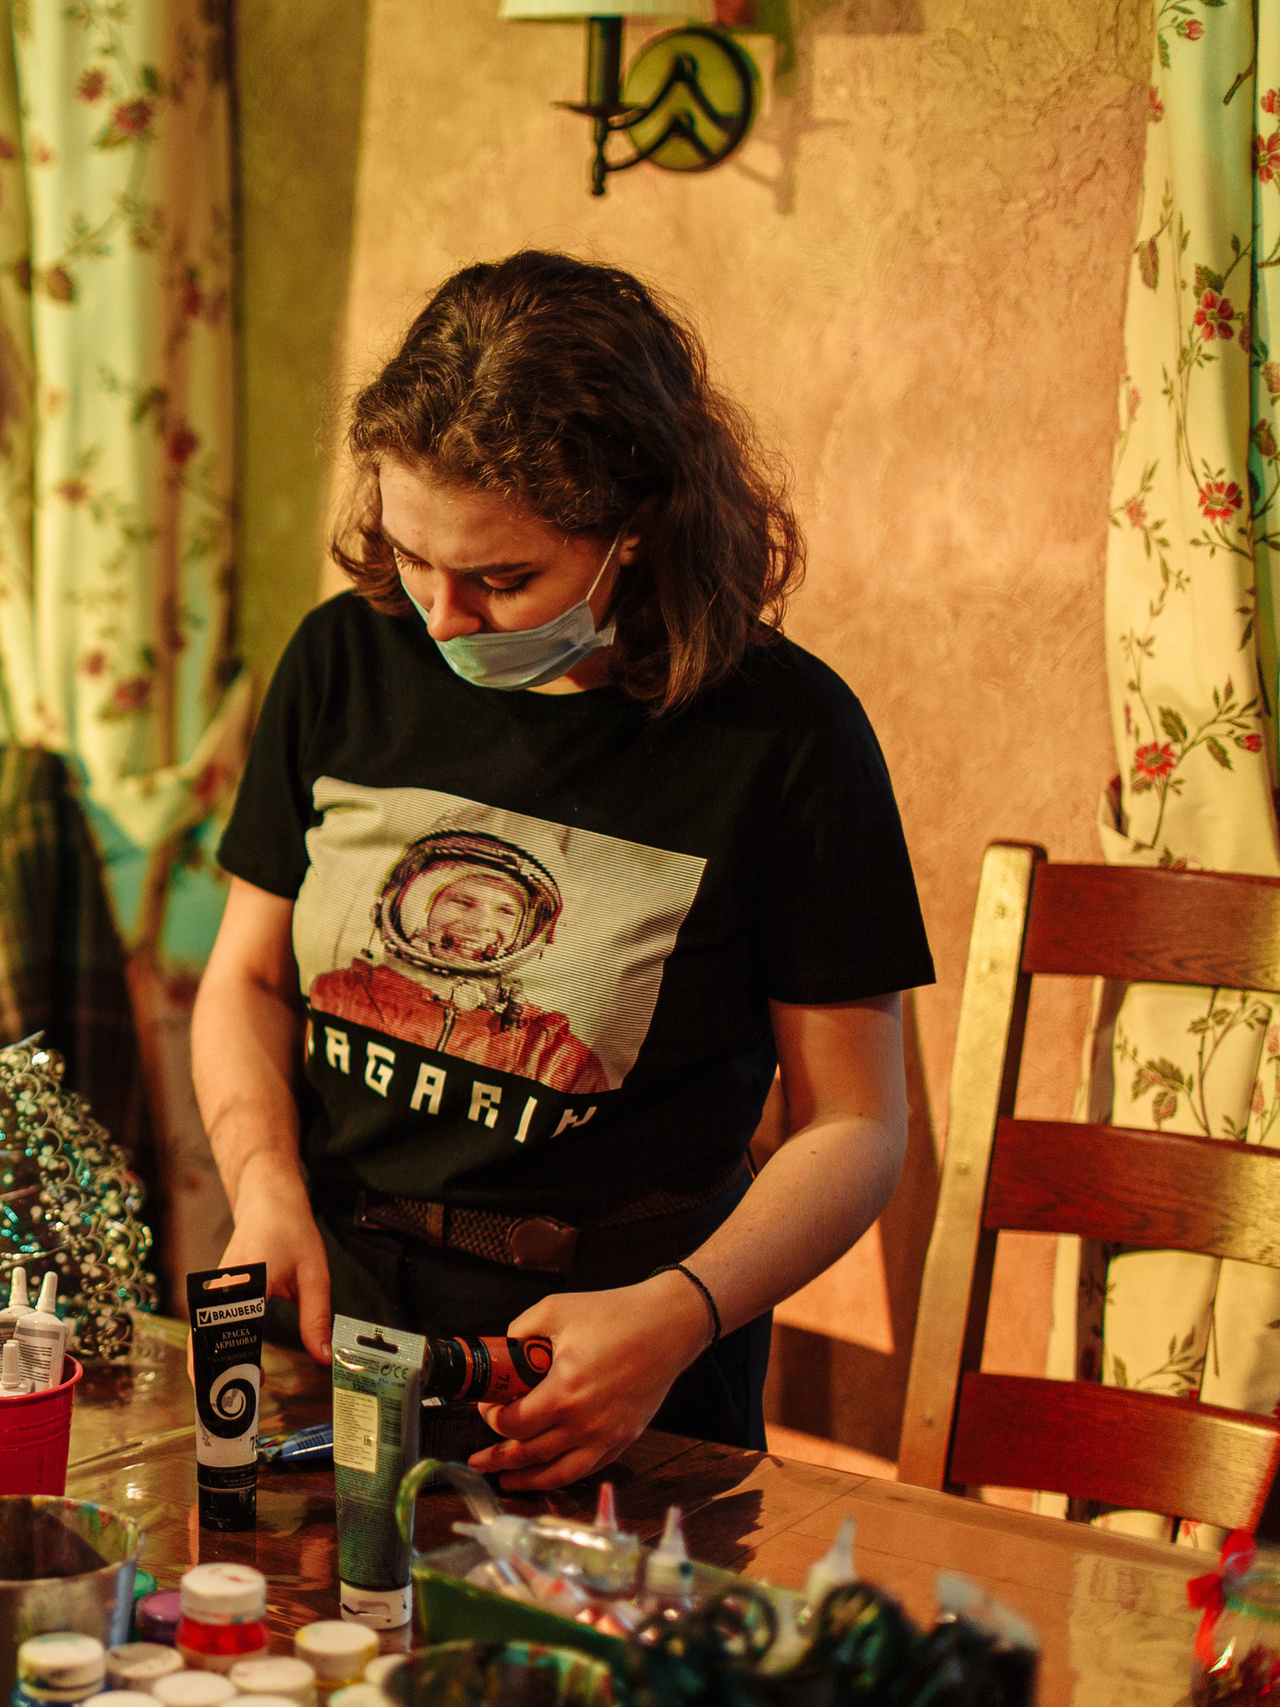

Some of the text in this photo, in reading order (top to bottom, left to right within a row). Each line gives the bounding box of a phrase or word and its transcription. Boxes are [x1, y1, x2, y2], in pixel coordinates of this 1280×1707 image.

[213, 1303, 262, 1320] BRAUBERG
[215, 1334, 257, 1350] АКРИЛОВАЯ
[222, 1328, 250, 1340] КРАСКА
